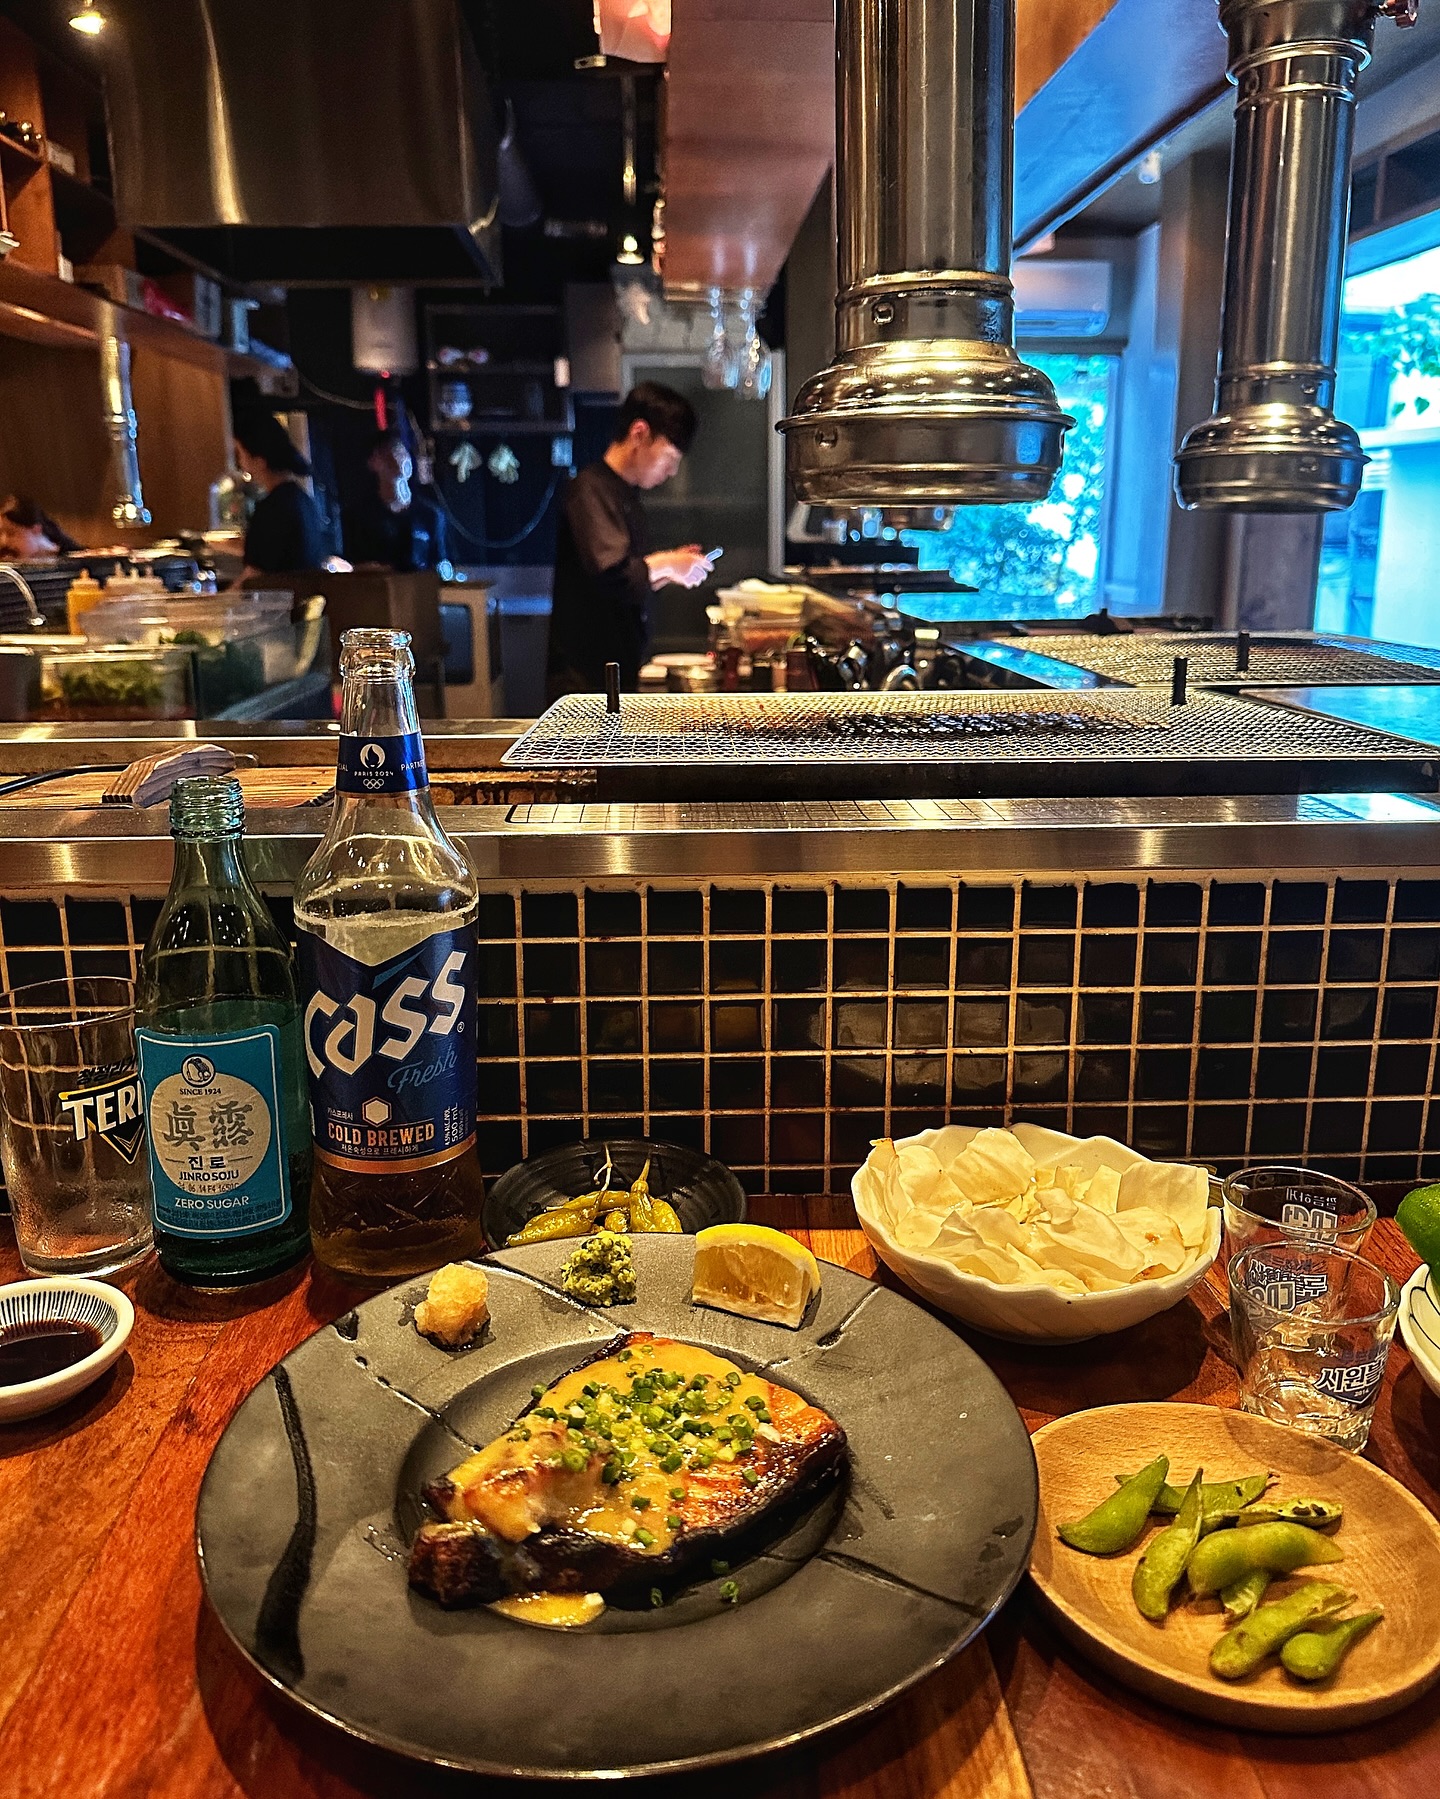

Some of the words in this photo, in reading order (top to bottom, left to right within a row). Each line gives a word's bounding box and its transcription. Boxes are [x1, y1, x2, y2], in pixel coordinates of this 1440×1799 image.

[387, 1046, 458, 1094] Fresh
[179, 1088, 203, 1096] SINCE
[204, 1087, 222, 1096] 1924
[328, 1122, 362, 1145] COLD
[367, 1123, 435, 1147] BREWED
[451, 1121, 459, 1142] 500
[188, 1155, 227, 1170] 진로
[179, 1171, 210, 1181] JINRO
[212, 1169, 239, 1181] SOJU
[174, 1197, 205, 1210] ZERO
[206, 1195, 249, 1210] SUGAR
